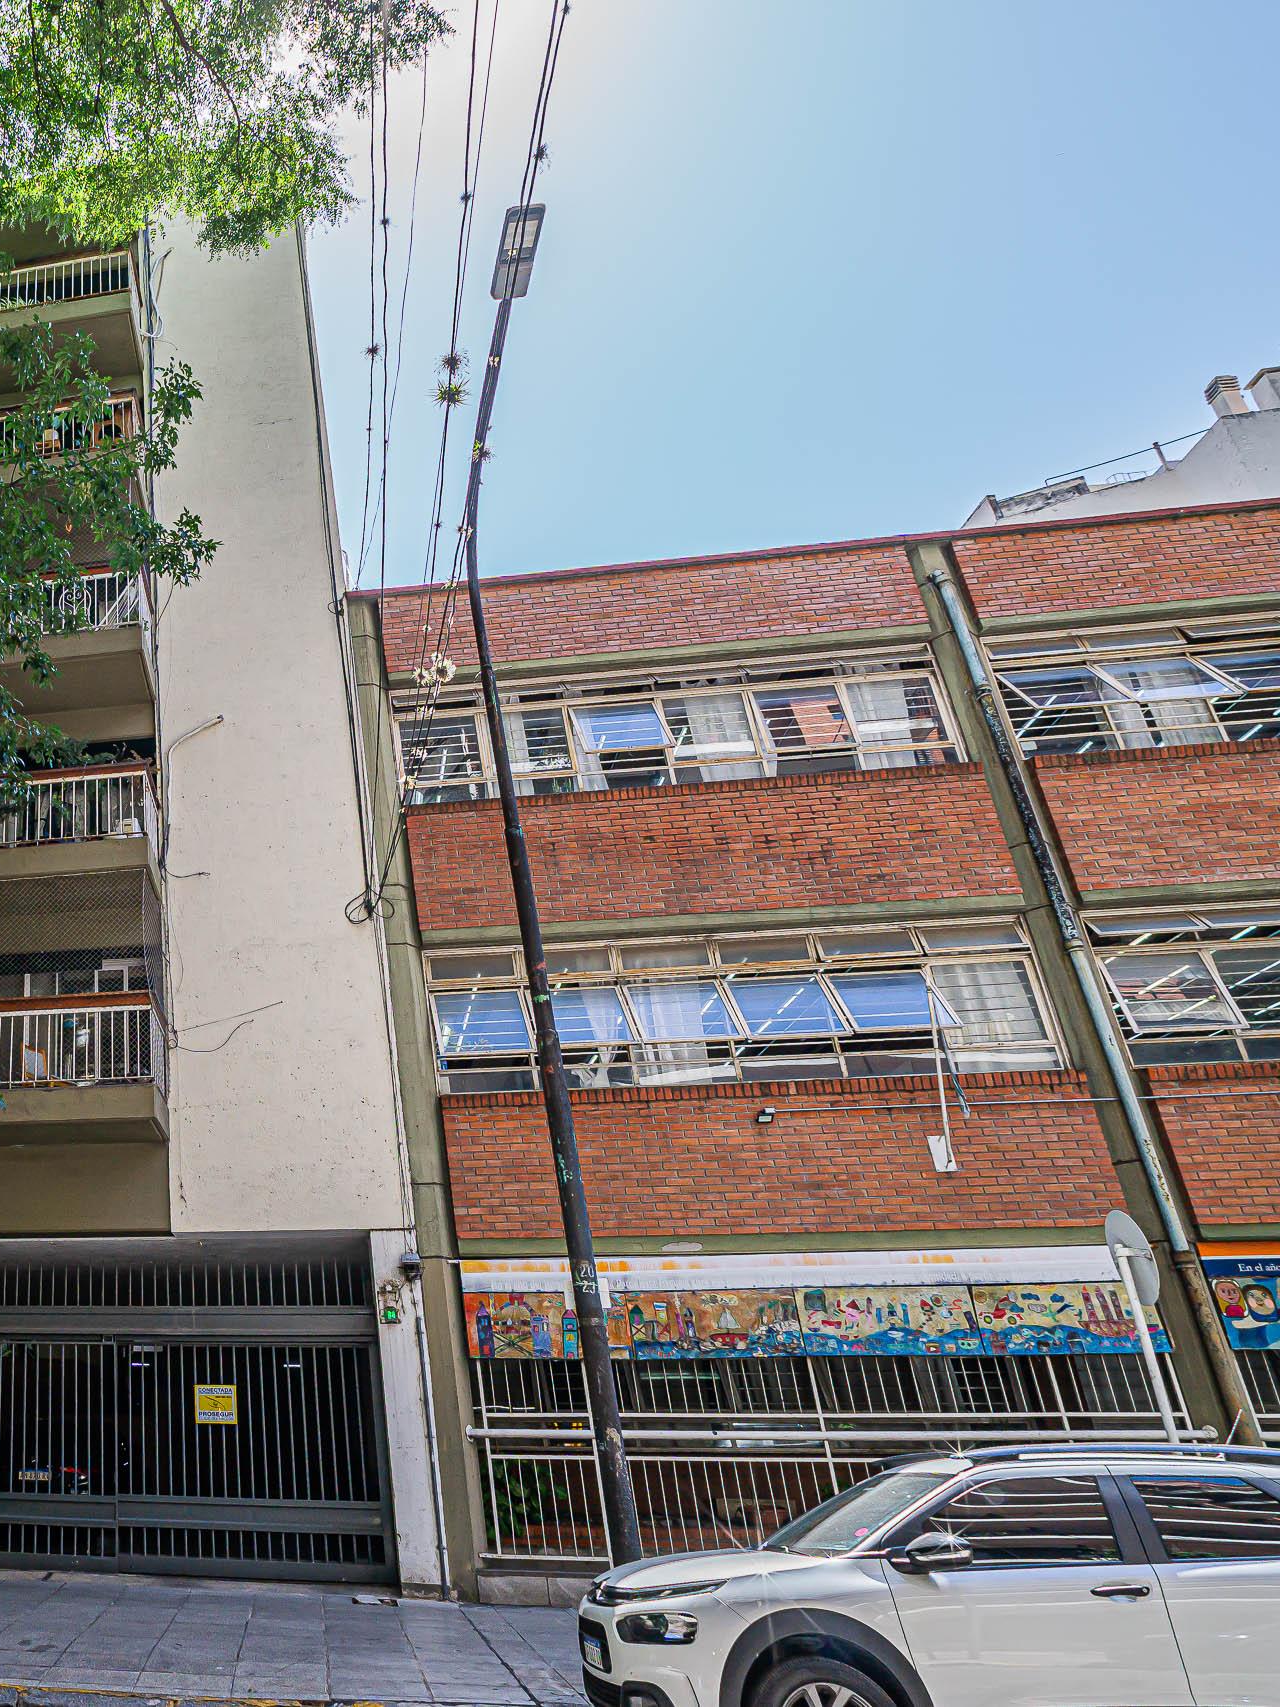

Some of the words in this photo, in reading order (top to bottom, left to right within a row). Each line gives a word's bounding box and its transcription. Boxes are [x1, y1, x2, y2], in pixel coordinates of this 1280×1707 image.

[579, 1263, 595, 1278] 20
[1237, 1263, 1254, 1272] En
[1254, 1262, 1264, 1272] el
